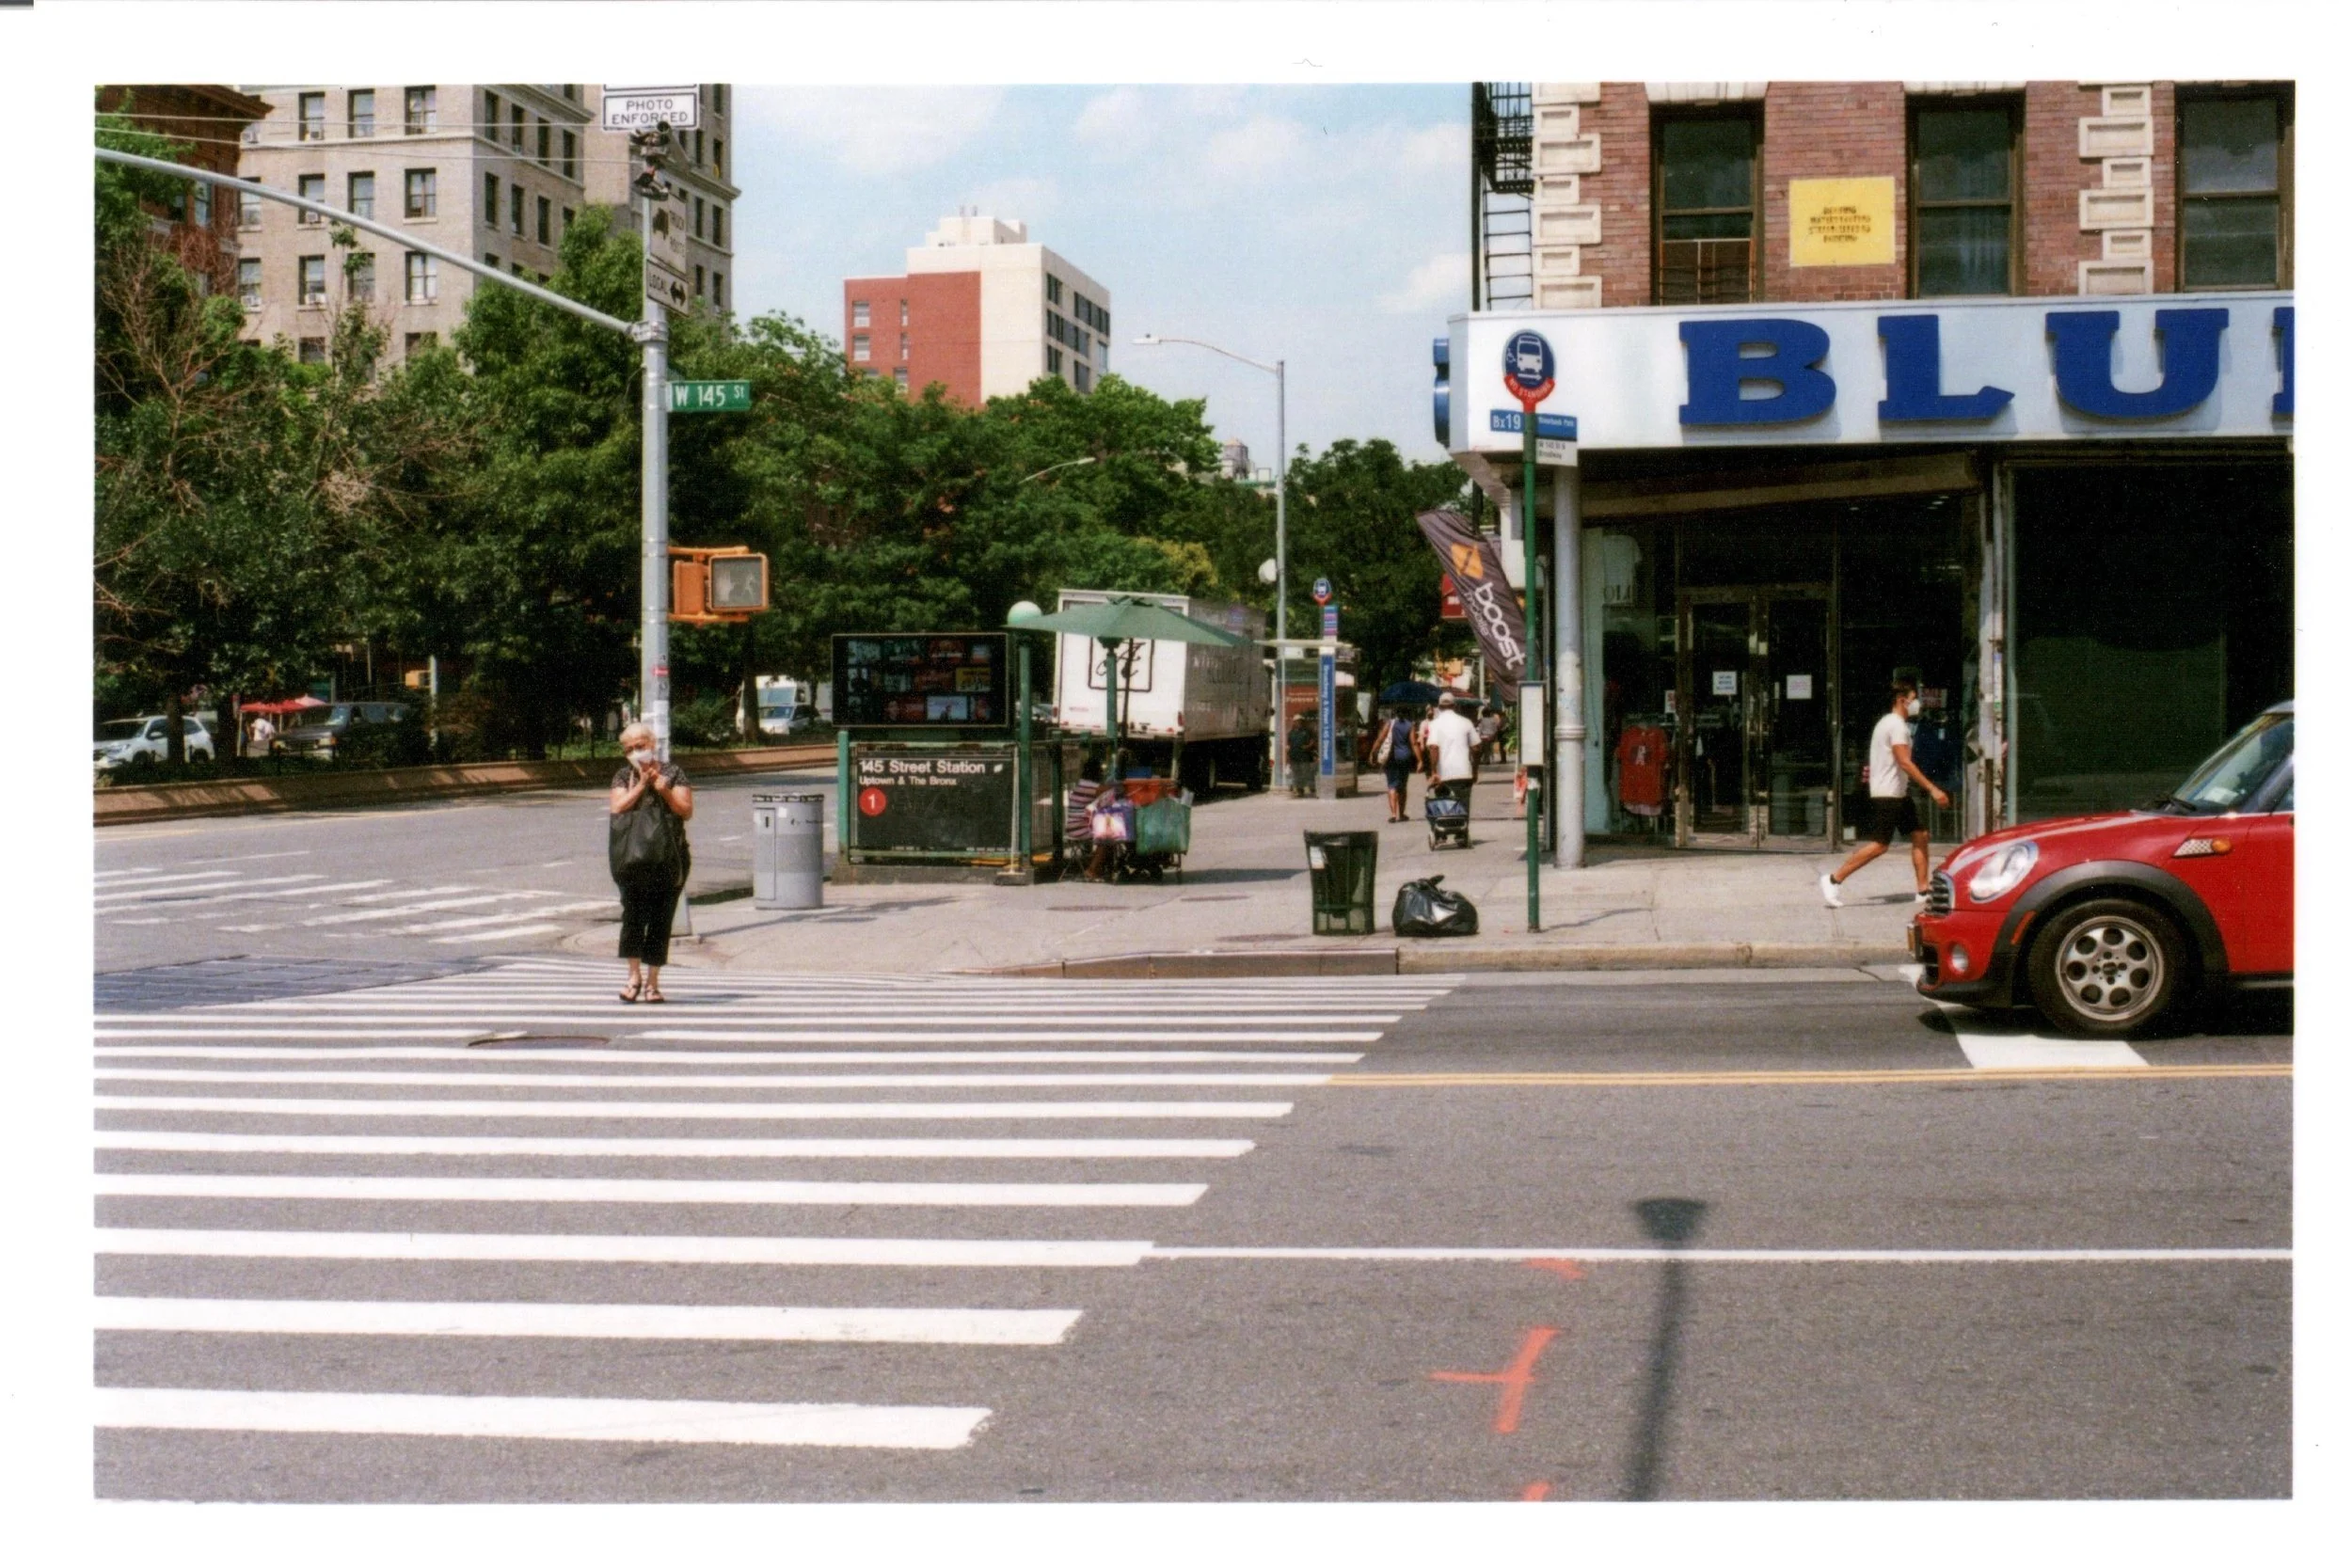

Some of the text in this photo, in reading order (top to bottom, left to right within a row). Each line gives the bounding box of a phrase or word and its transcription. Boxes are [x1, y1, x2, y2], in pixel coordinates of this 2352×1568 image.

[626, 99, 674, 111] PHOTO
[612, 112, 689, 125] ENFORCED
[675, 386, 689, 406] W
[697, 385, 726, 407] 145
[1492, 413, 1522, 431] Bx19
[1474, 581, 1526, 672] boost
[859, 759, 986, 774] 145 Street Station
[858, 775, 957, 786] Uptown & The Bronx
